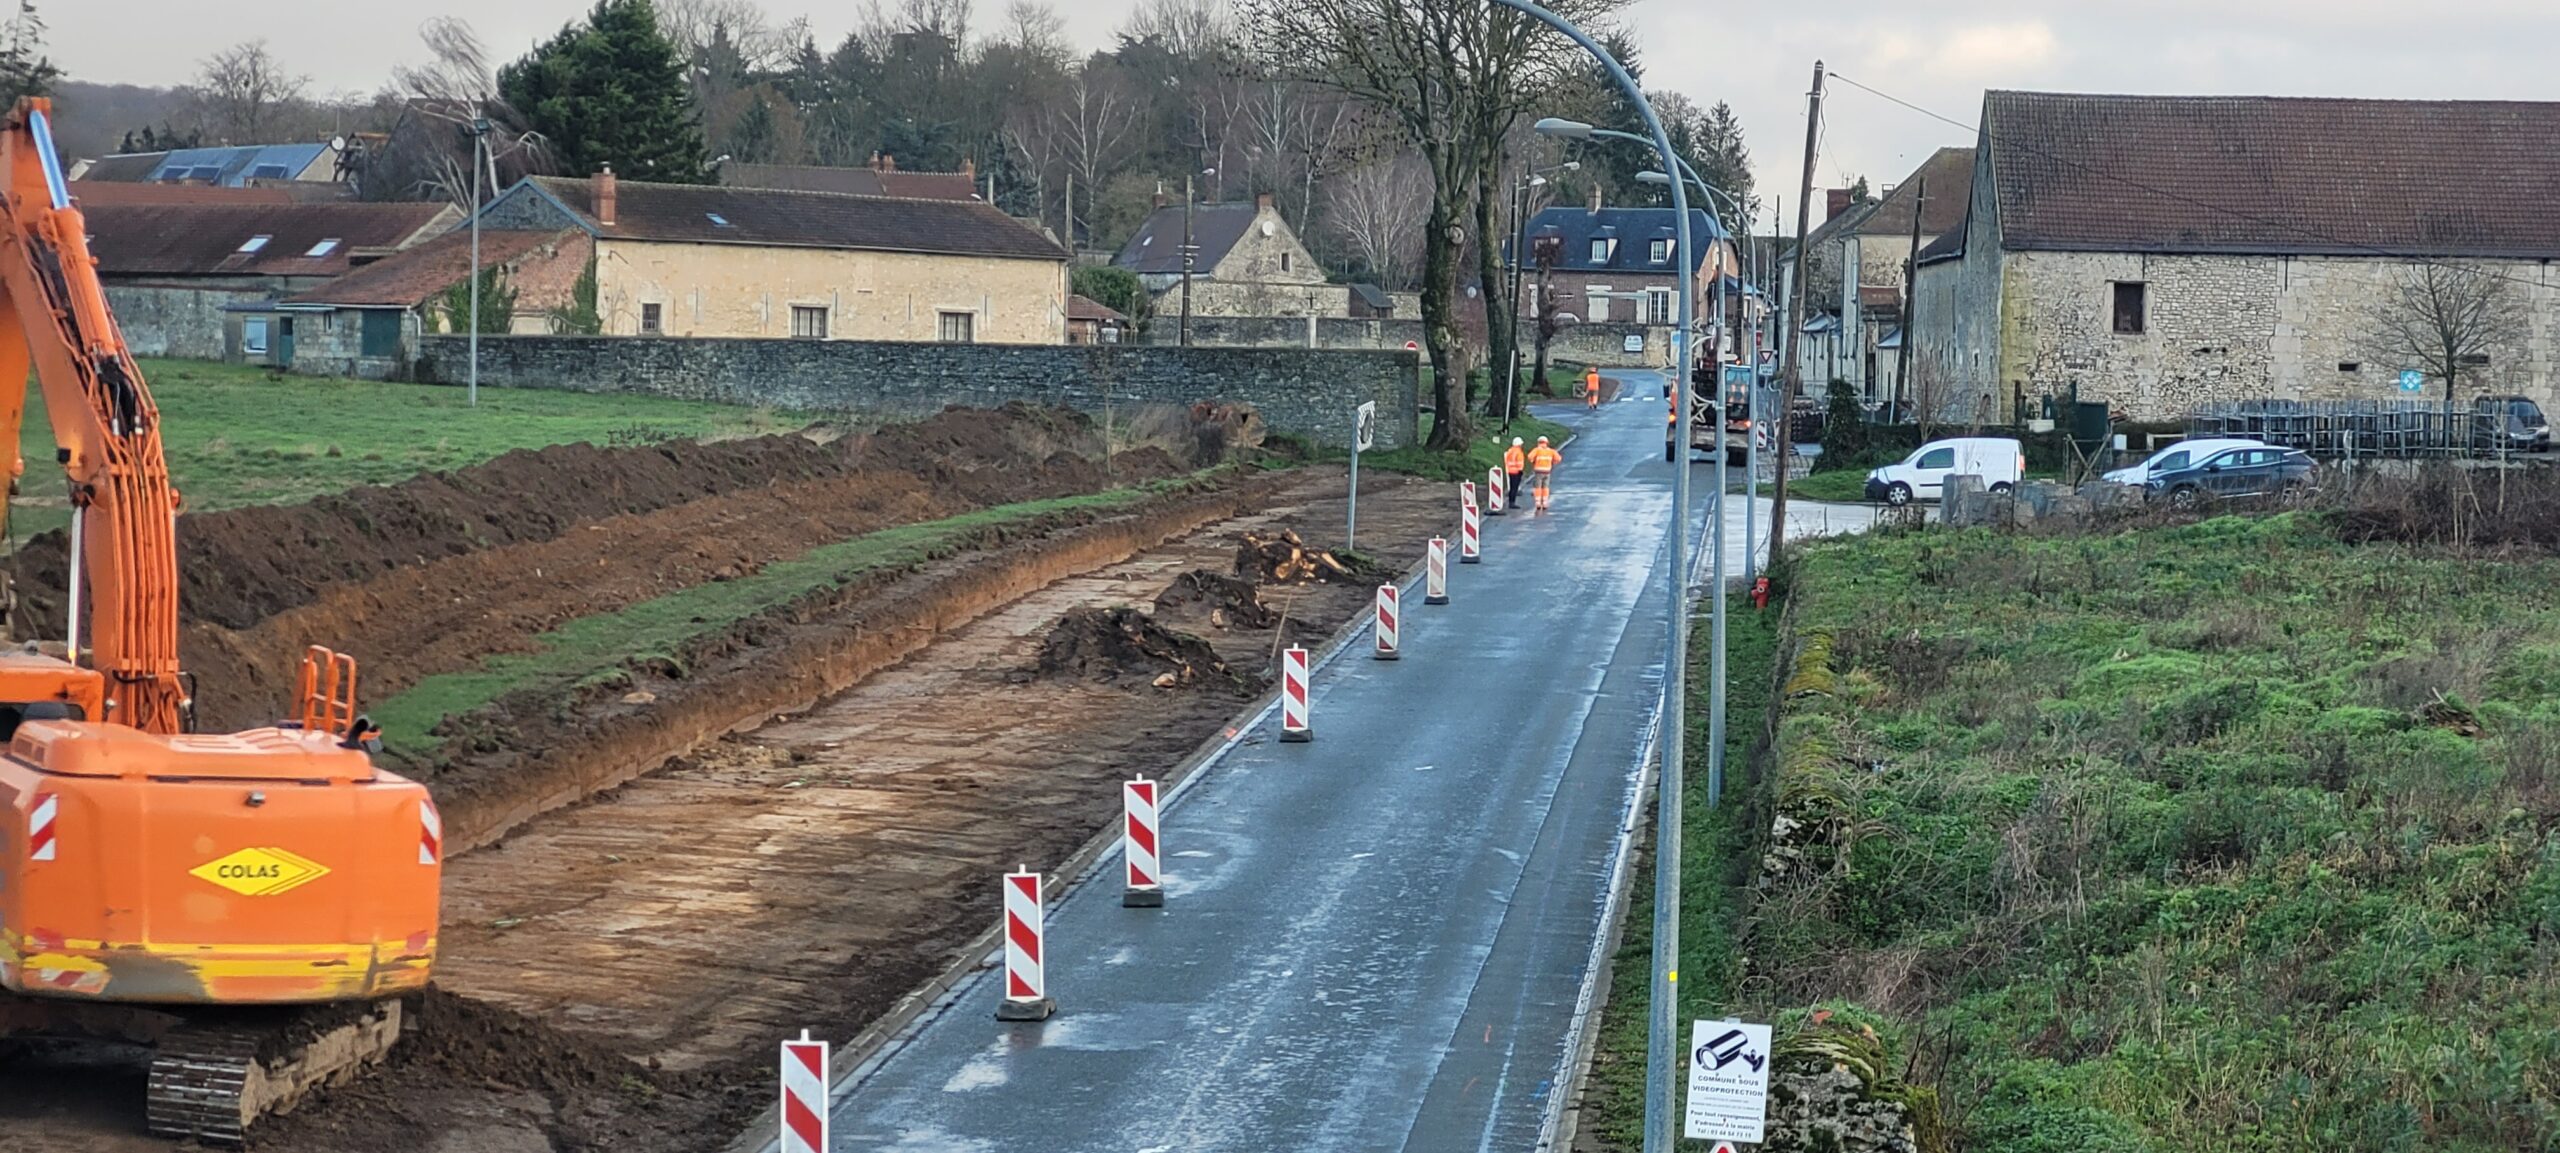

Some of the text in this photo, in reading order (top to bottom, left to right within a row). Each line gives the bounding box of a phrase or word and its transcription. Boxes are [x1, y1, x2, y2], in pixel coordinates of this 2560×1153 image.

[218, 864, 280, 878] COLAS
[1697, 1075, 1736, 1084] COMMUNE
[1692, 1084, 1763, 1097] VIDEOPROTECTION
